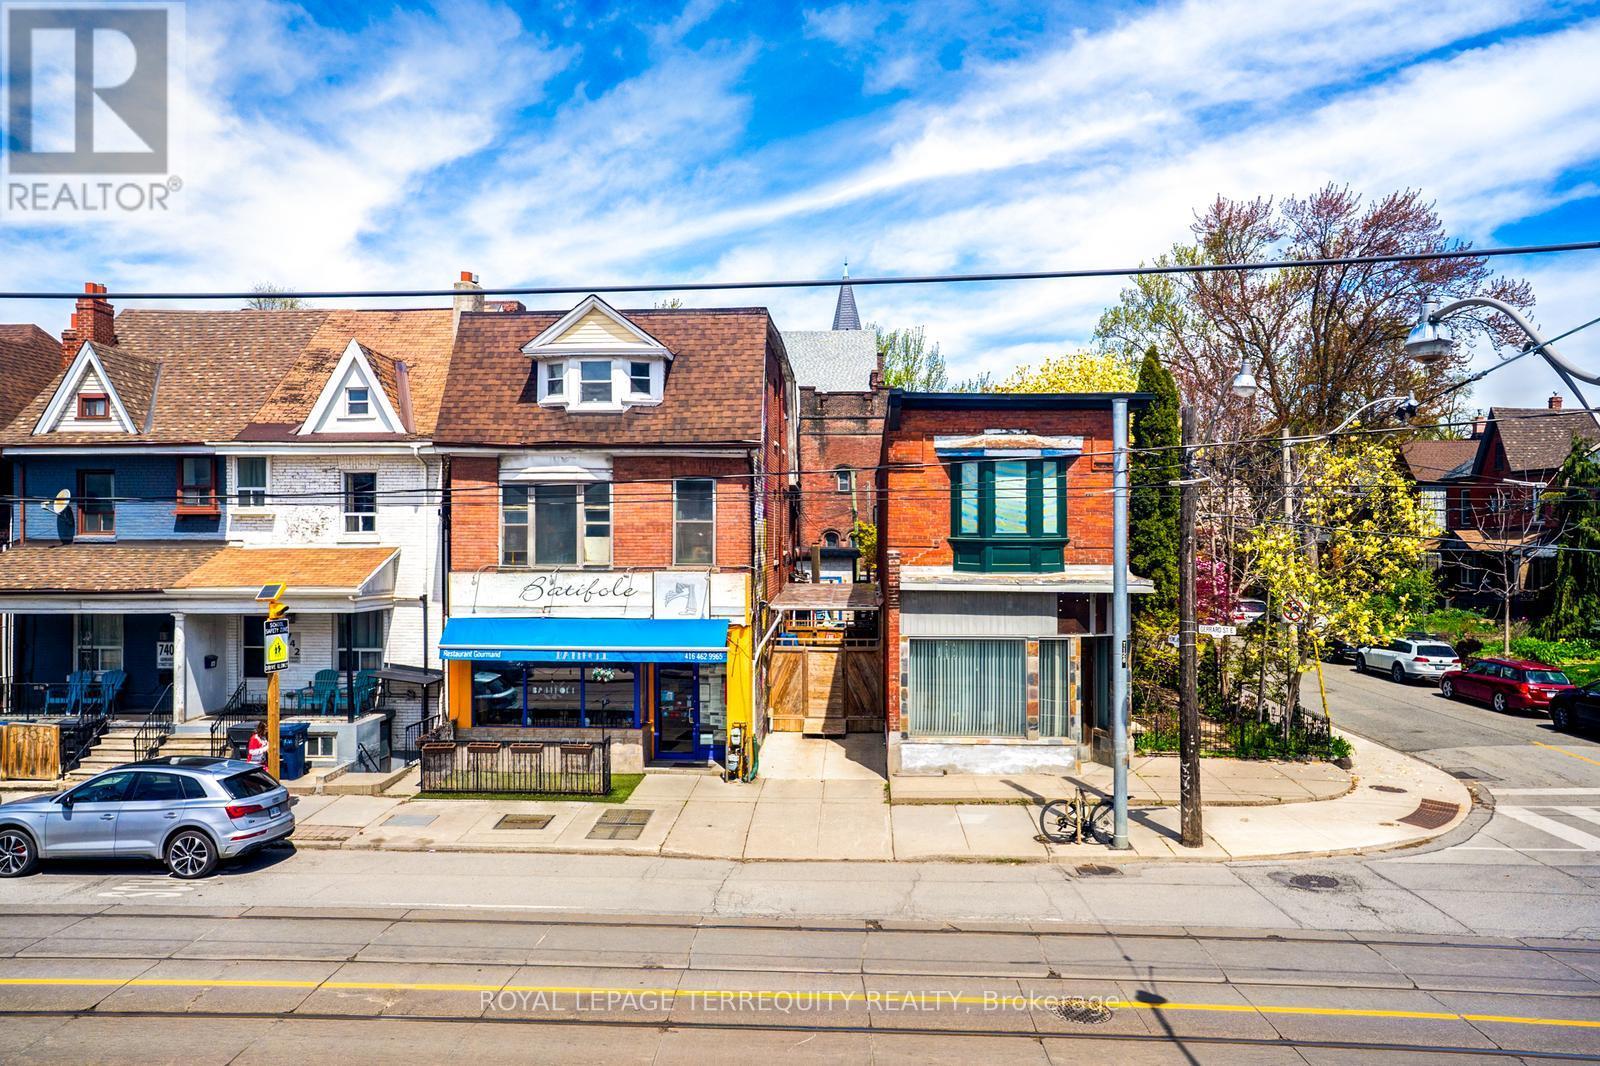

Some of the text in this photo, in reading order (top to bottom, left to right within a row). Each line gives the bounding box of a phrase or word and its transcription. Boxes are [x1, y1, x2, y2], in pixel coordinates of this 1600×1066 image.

[519, 576, 638, 603] Batifole
[1199, 625, 1222, 634] GERRARD
[158, 643, 174, 656] 740
[443, 650, 502, 659] Restaurant Gourmand
[684, 652, 696, 660] 416
[696, 652, 708, 661] 462
